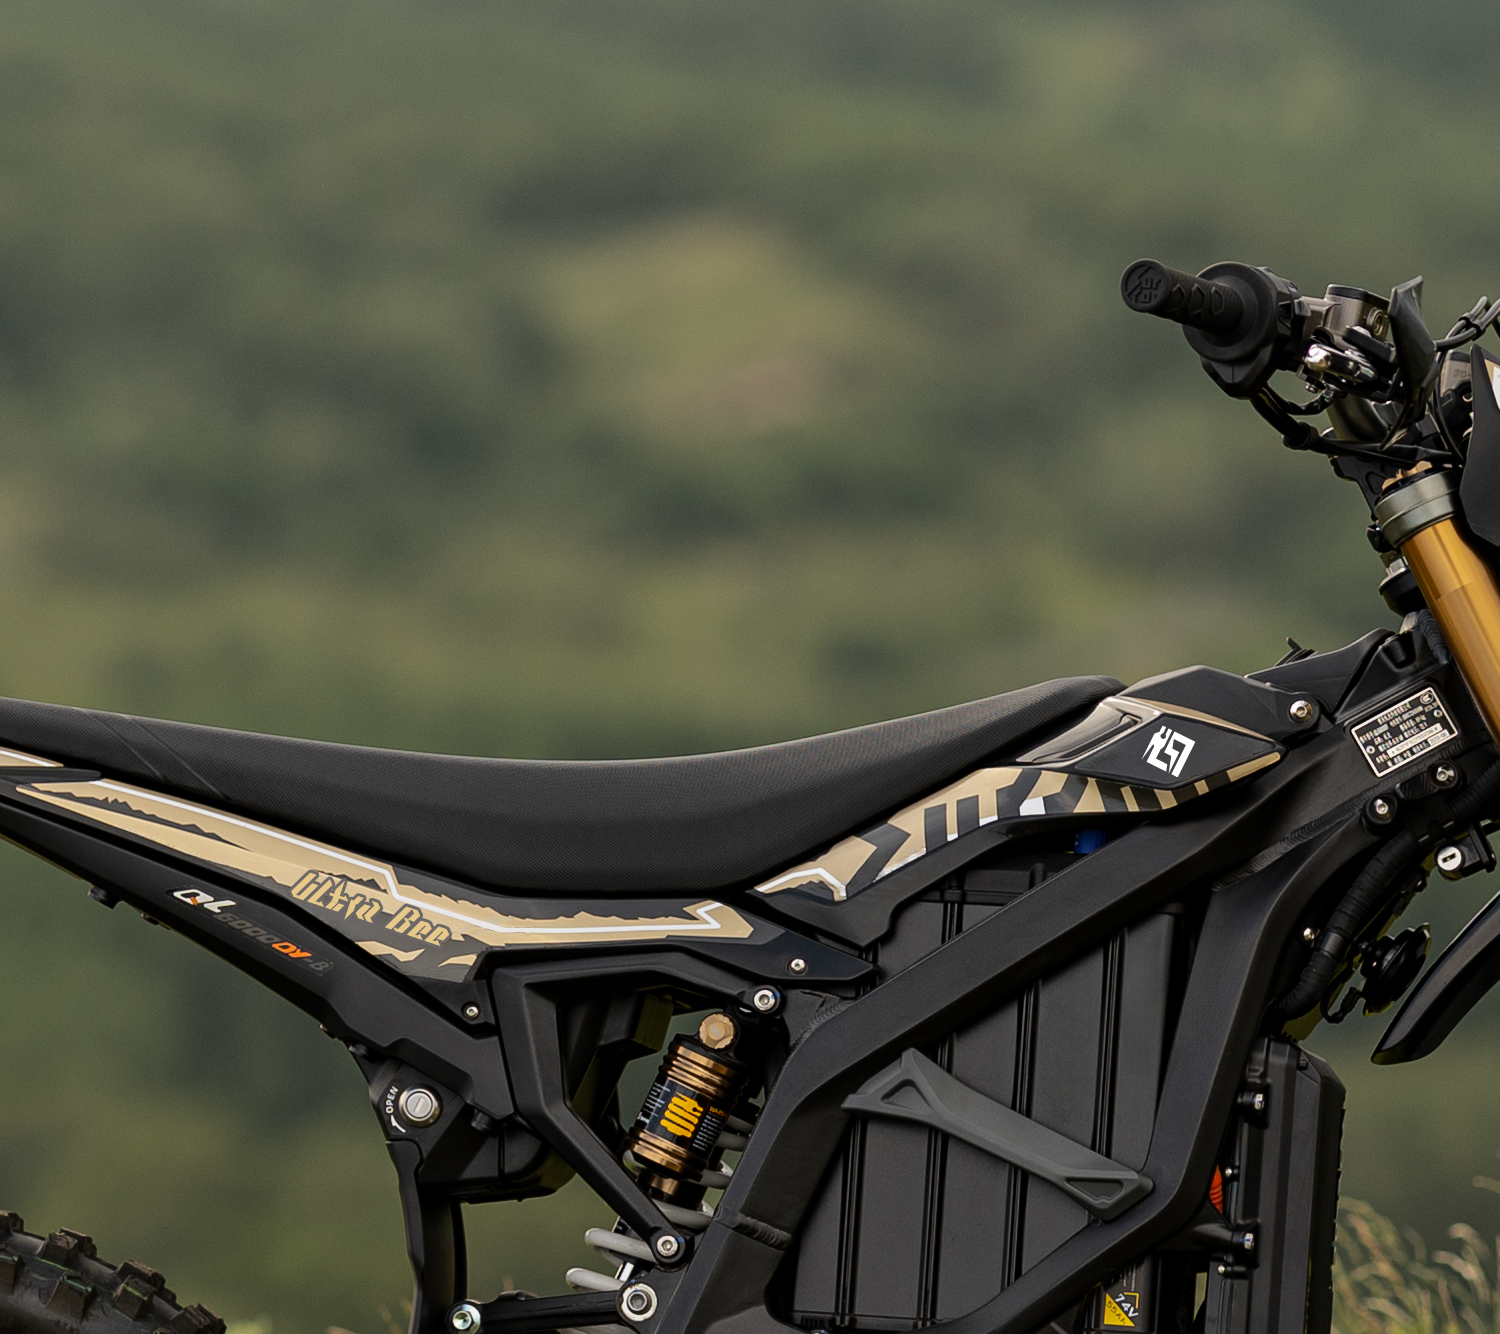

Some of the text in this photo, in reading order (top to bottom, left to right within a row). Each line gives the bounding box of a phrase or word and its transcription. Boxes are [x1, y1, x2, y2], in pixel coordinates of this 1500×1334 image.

[385, 903, 453, 947] Bee
[385, 1085, 399, 1114] OPEN
[1114, 1293, 1139, 1318] 74V
